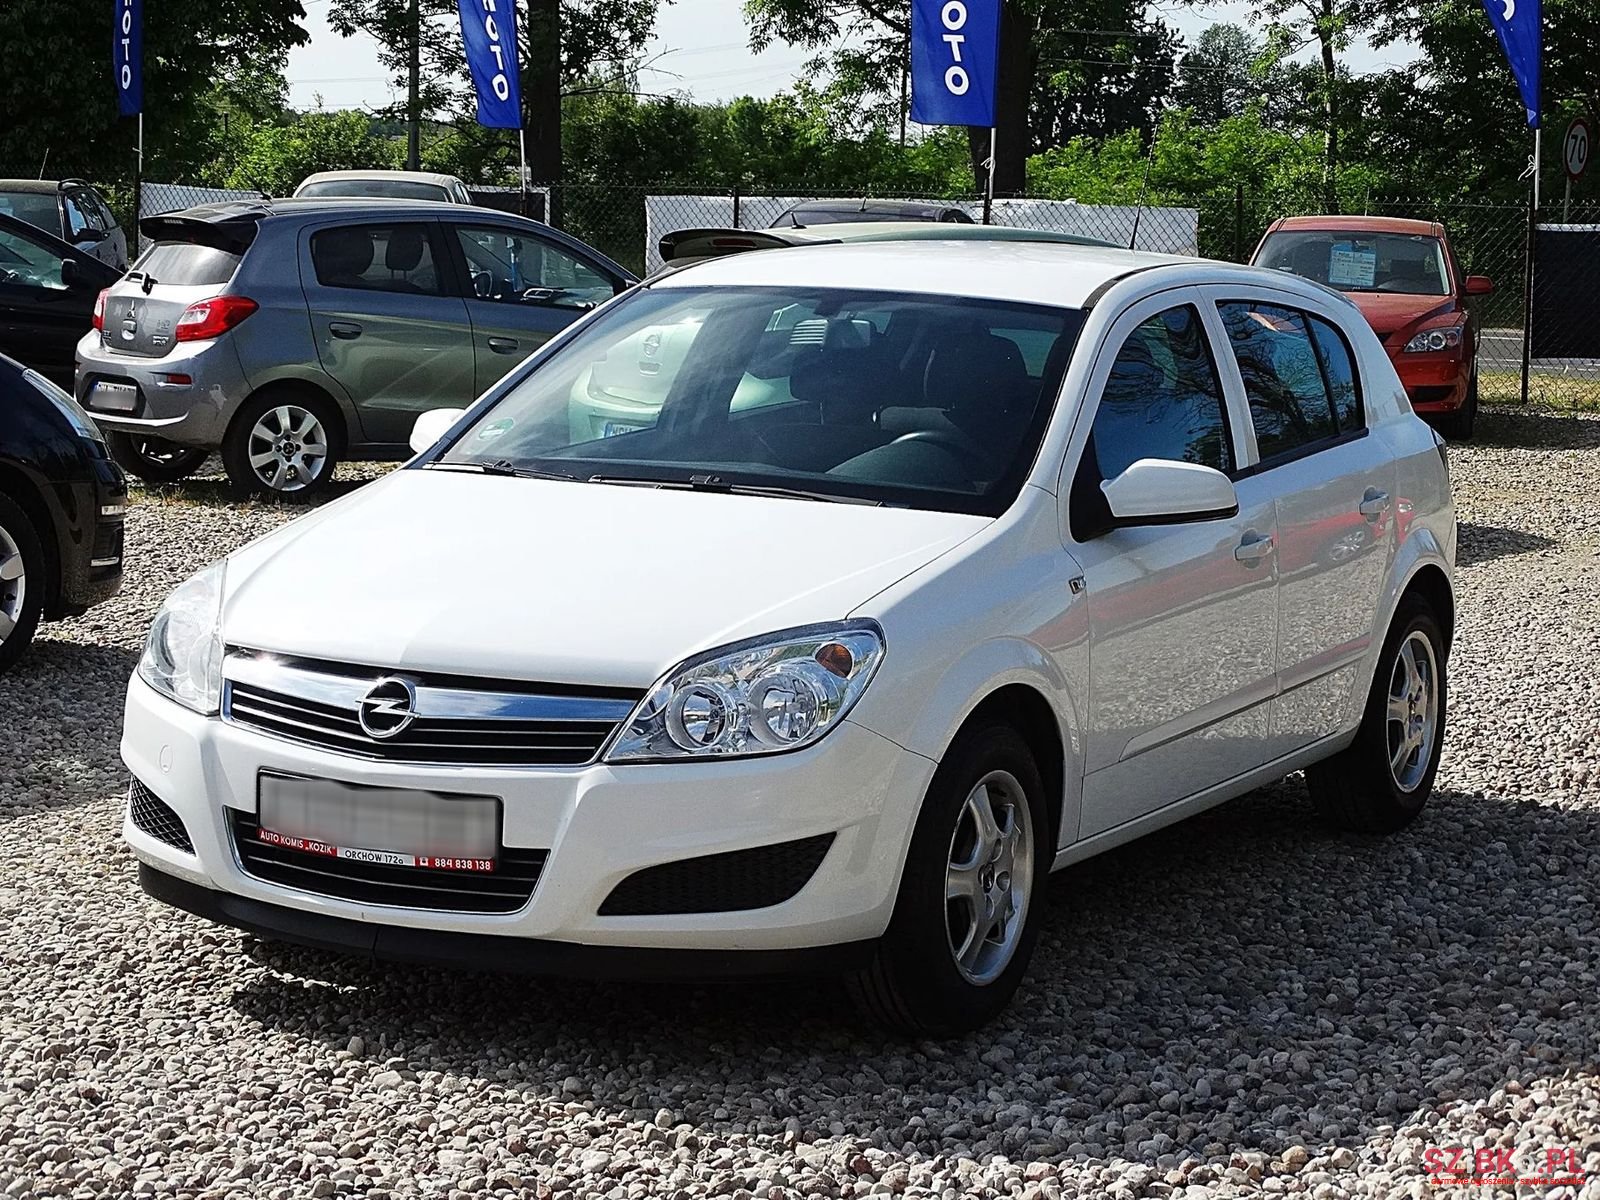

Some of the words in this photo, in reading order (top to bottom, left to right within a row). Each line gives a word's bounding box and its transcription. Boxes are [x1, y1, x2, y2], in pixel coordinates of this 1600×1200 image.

[121, 0, 132, 90] OTO
[1569, 133, 1587, 164] 70
[260, 830, 280, 843] AUTO
[280, 835, 304, 849] KOMIS
[434, 857, 453, 868] 884
[455, 859, 473, 869] 838
[475, 860, 491, 871] 138
